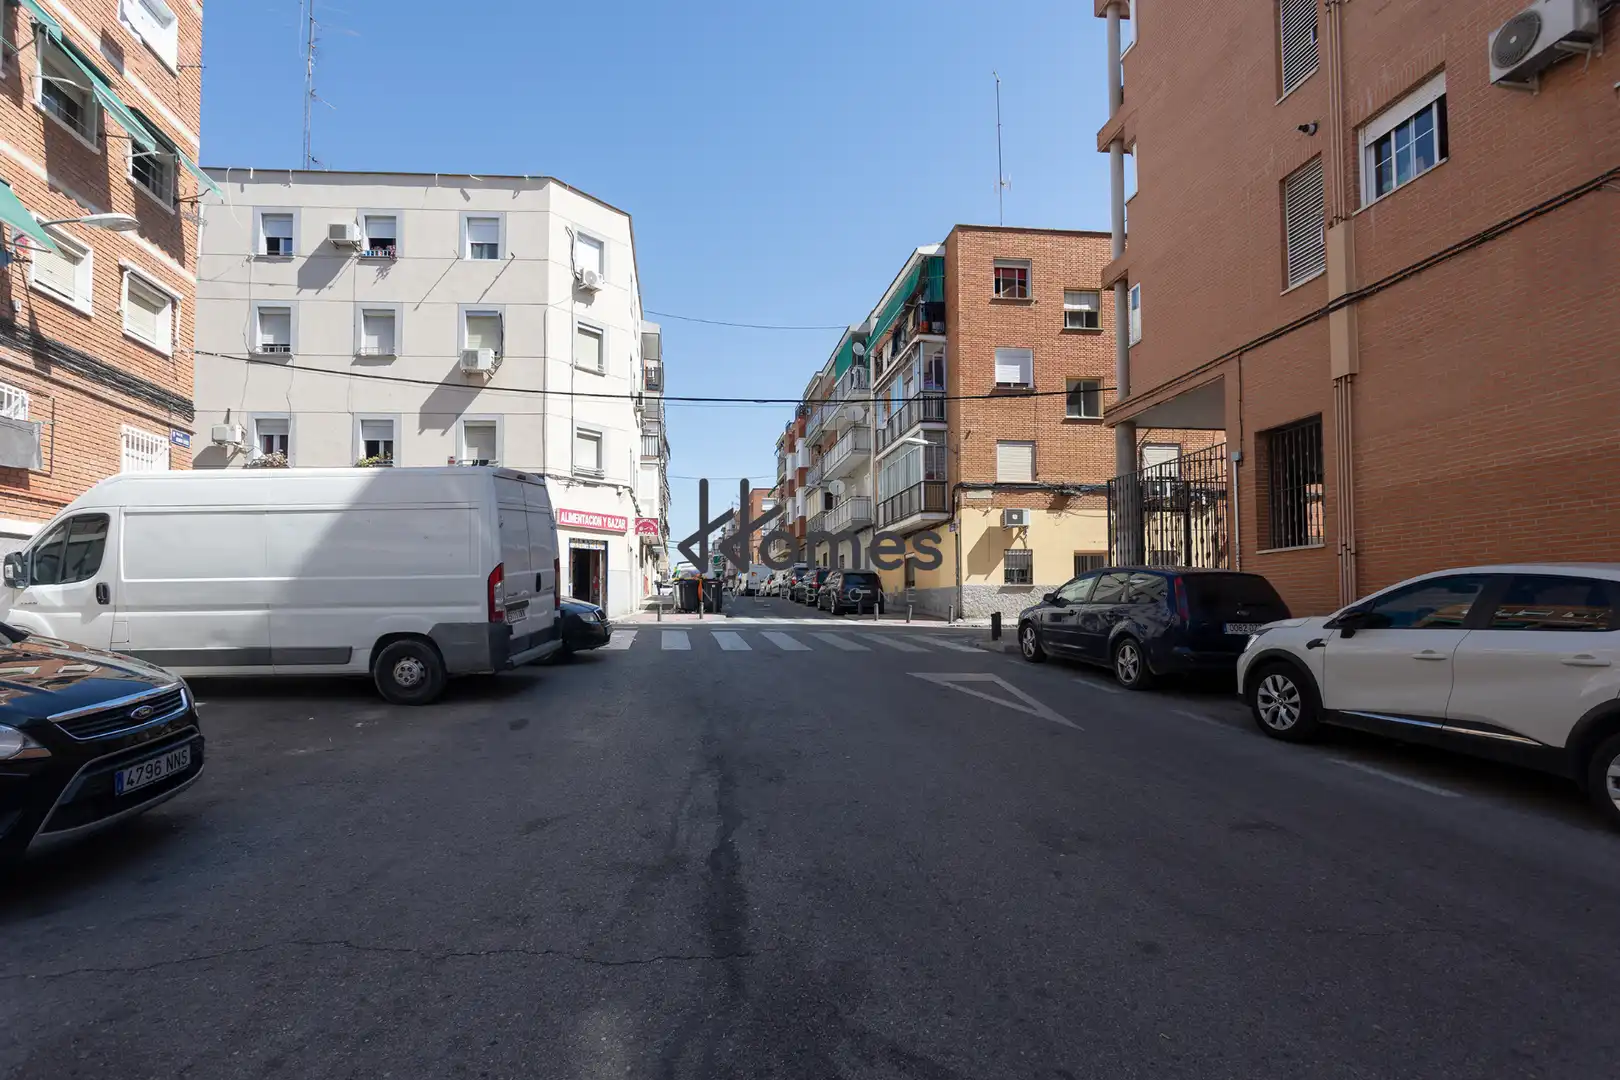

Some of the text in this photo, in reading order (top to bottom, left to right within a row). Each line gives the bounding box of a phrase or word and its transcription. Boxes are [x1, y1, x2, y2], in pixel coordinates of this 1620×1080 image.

[602, 517, 607, 527] Y
[607, 517, 627, 530] BAZAR
[126, 749, 188, 787] 4796 NNS
